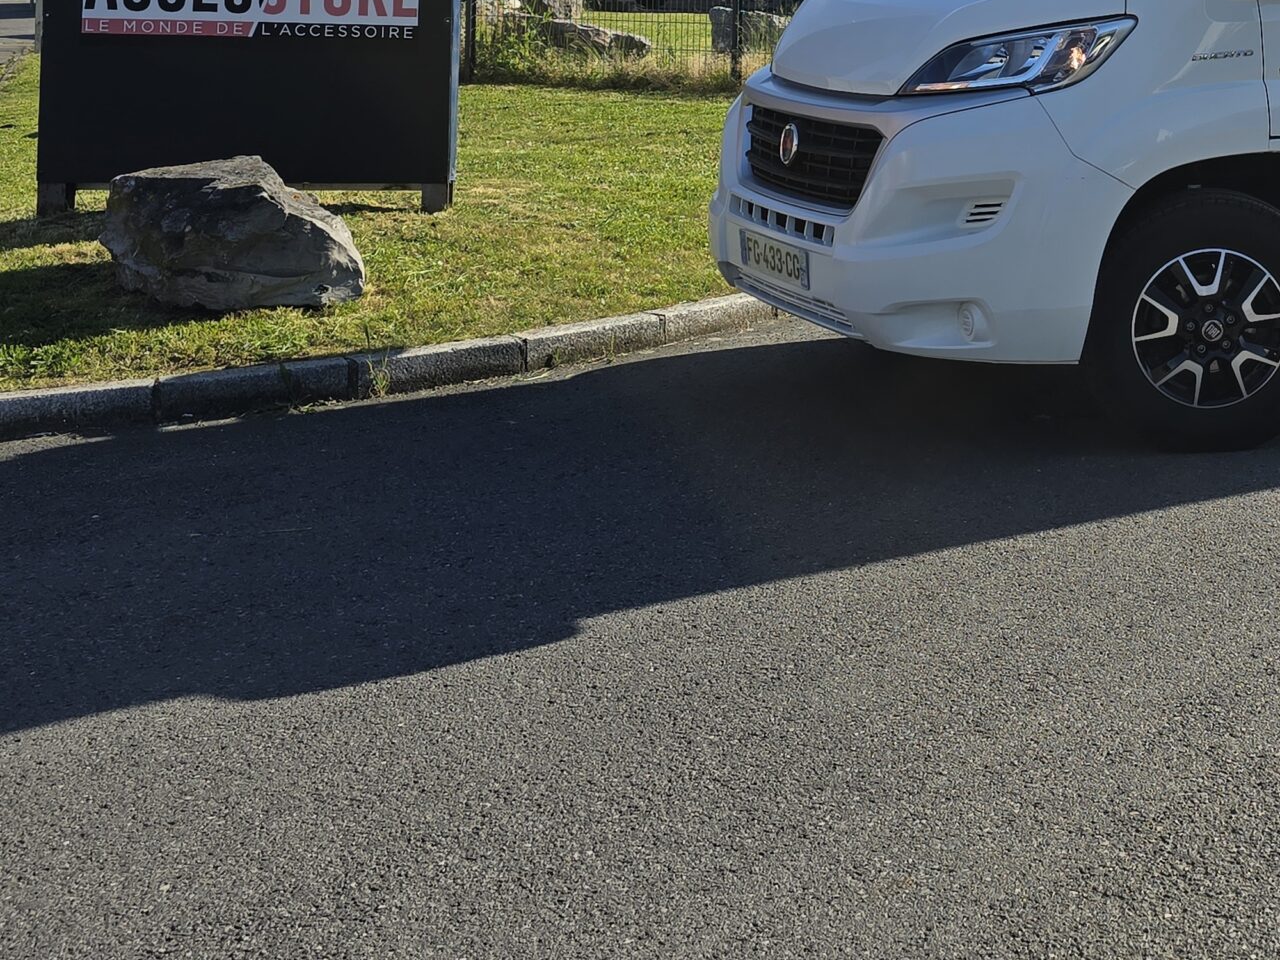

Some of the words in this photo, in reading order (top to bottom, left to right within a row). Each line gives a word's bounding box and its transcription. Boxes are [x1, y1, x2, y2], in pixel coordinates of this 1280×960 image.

[85, 19, 109, 32] LE
[123, 20, 202, 34] MONDE
[216, 22, 243, 35] DE
[261, 24, 414, 39] L'ACCESSOIRE
